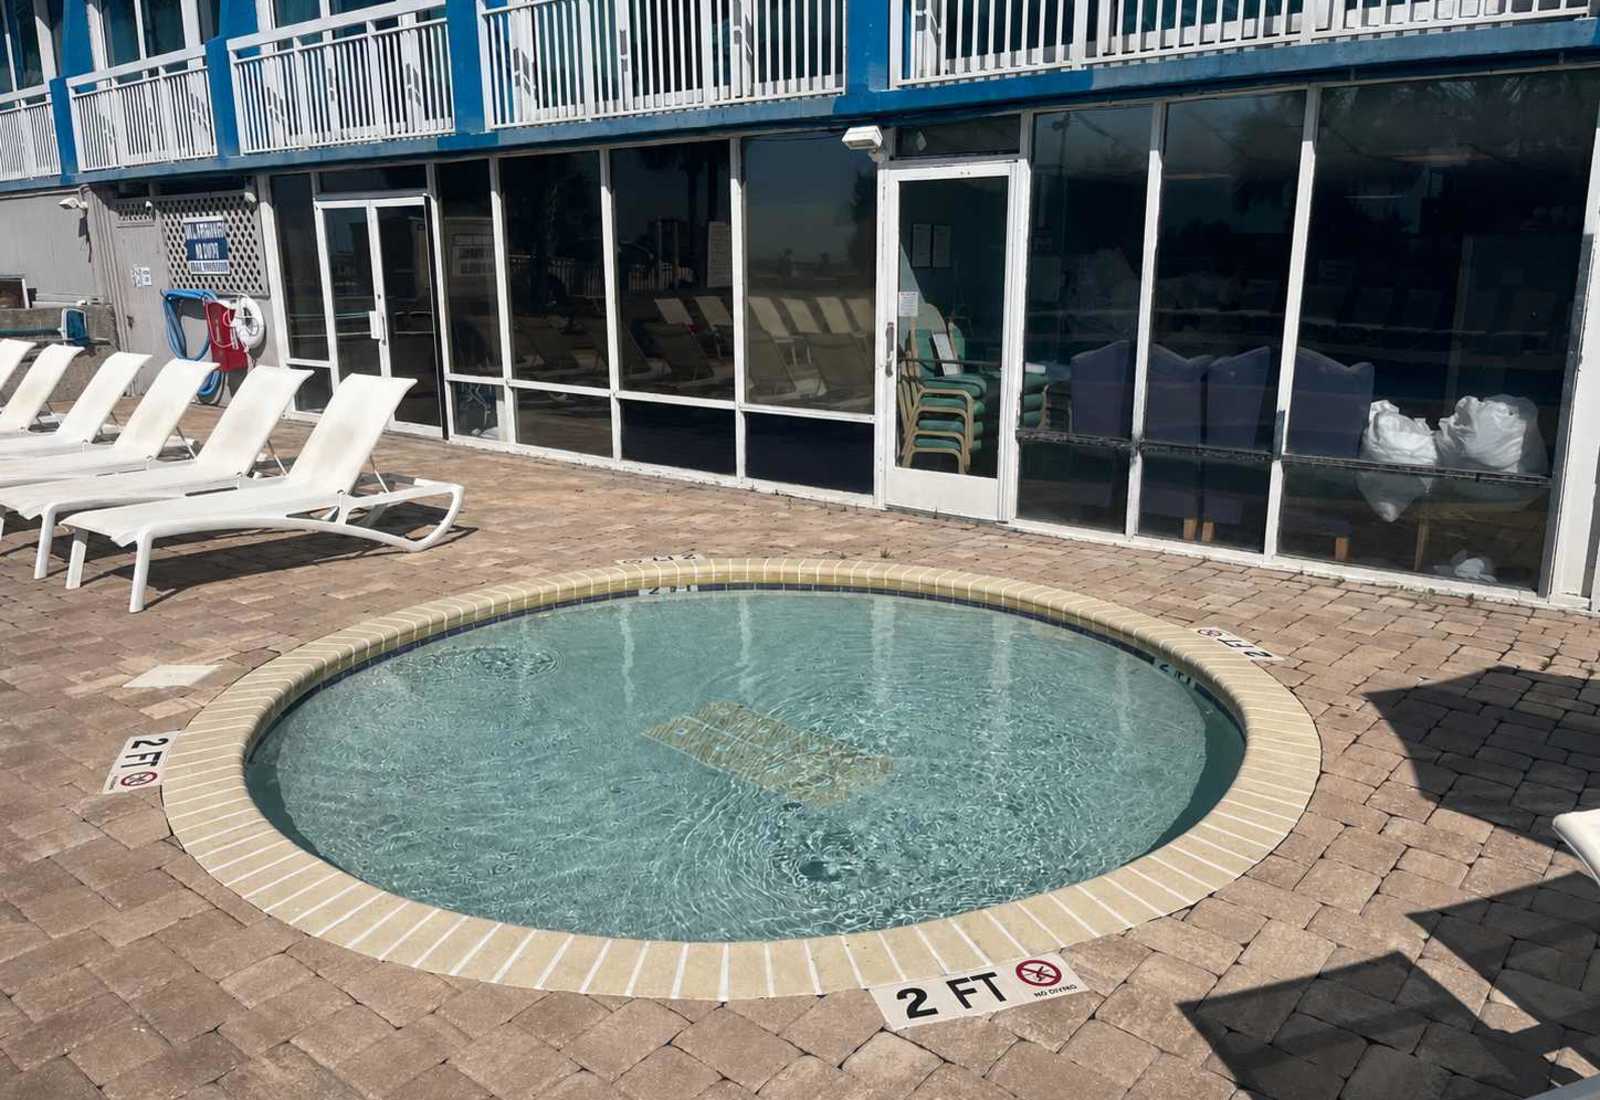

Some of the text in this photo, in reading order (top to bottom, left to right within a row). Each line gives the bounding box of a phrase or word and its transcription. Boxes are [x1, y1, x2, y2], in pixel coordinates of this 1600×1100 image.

[121, 737, 169, 768] 2 FT
[896, 971, 1008, 1019] 2 FT
